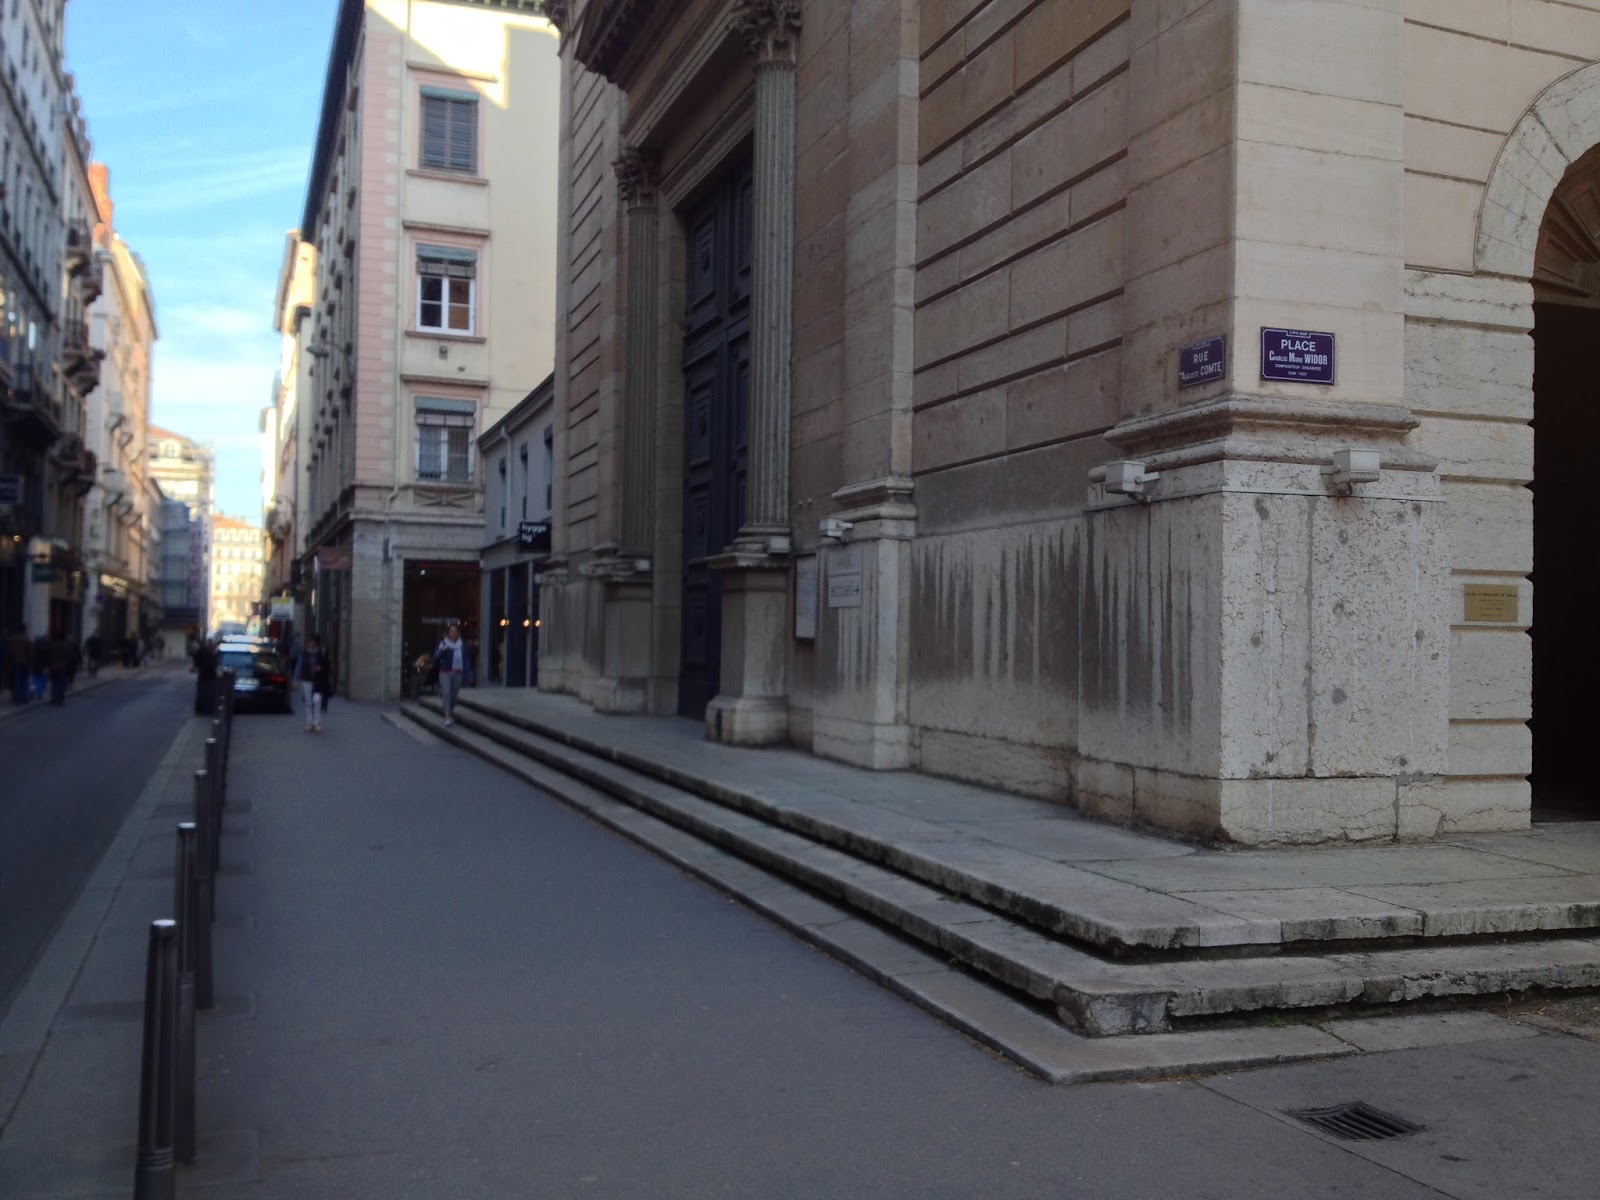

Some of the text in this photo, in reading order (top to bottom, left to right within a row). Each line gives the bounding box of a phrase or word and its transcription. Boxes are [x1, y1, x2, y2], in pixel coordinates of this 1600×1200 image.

[1281, 339, 1316, 352] PLACE
[1193, 350, 1209, 364] RUE
[1304, 353, 1328, 366] WIDOR
[1200, 361, 1222, 376] COMTE
[521, 523, 547, 533] hygge
